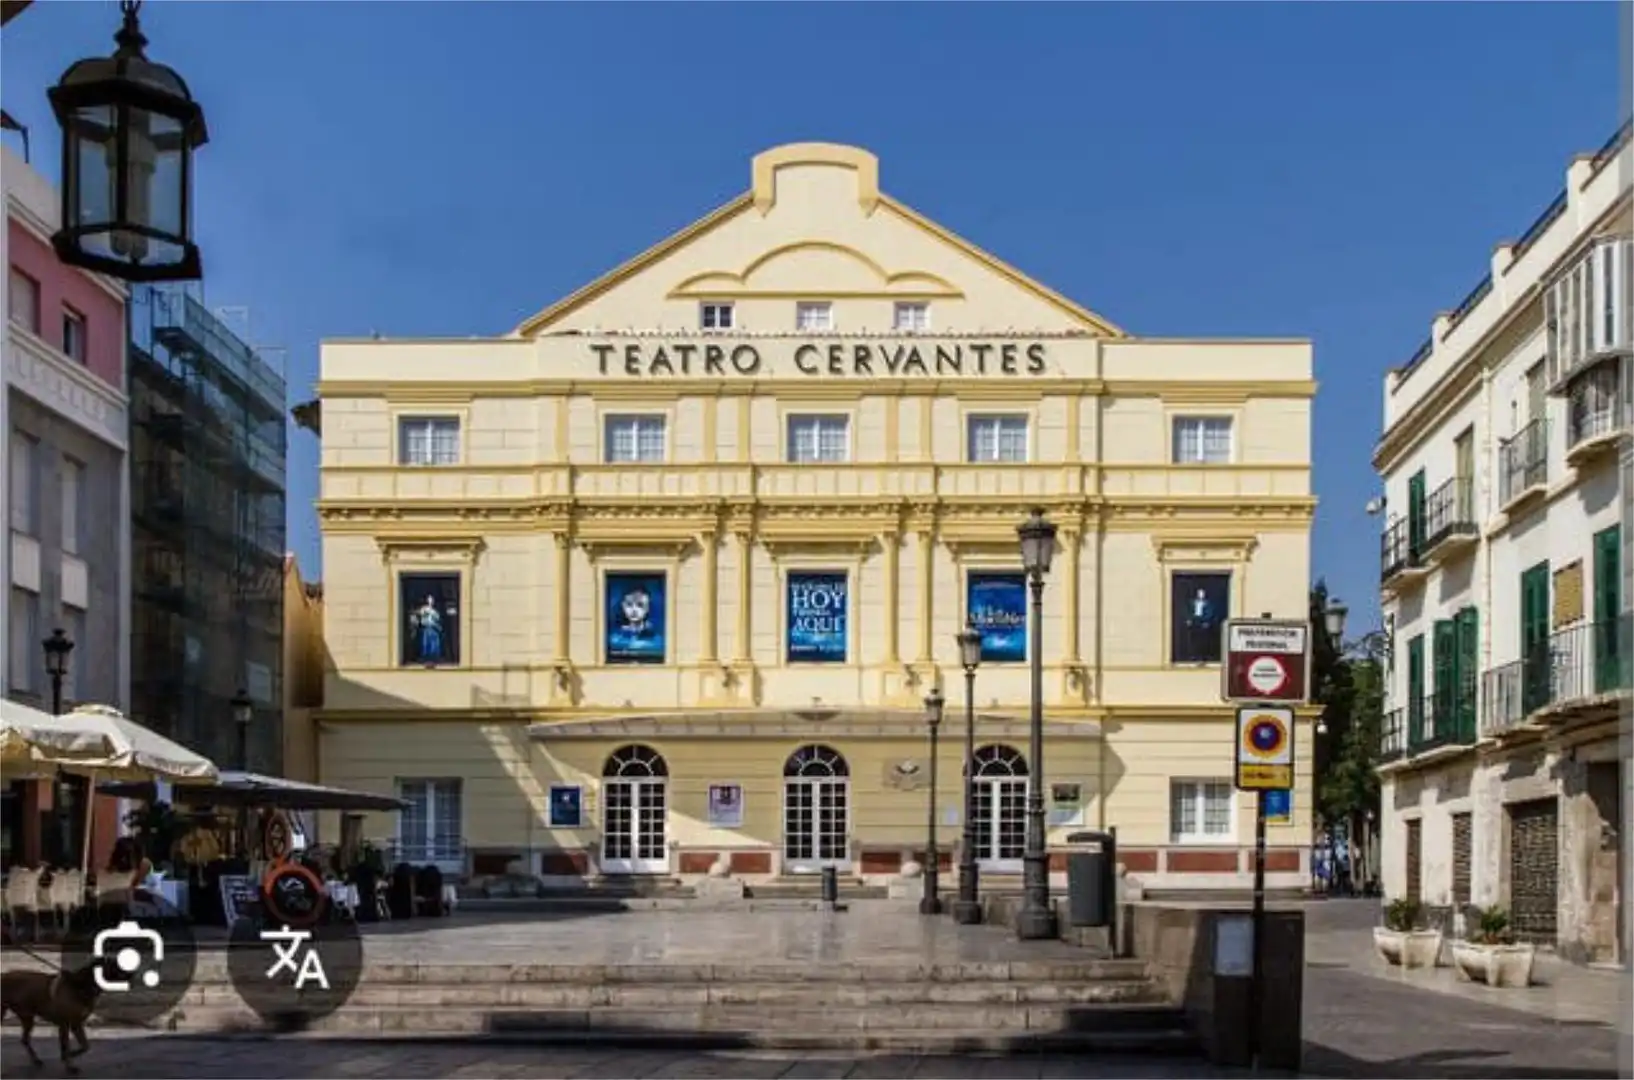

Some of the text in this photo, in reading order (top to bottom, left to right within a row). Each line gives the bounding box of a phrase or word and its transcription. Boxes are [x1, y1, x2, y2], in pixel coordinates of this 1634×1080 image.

[590, 344, 1046, 375] TEATRO CERVANTES
[793, 589, 844, 609] HOY
